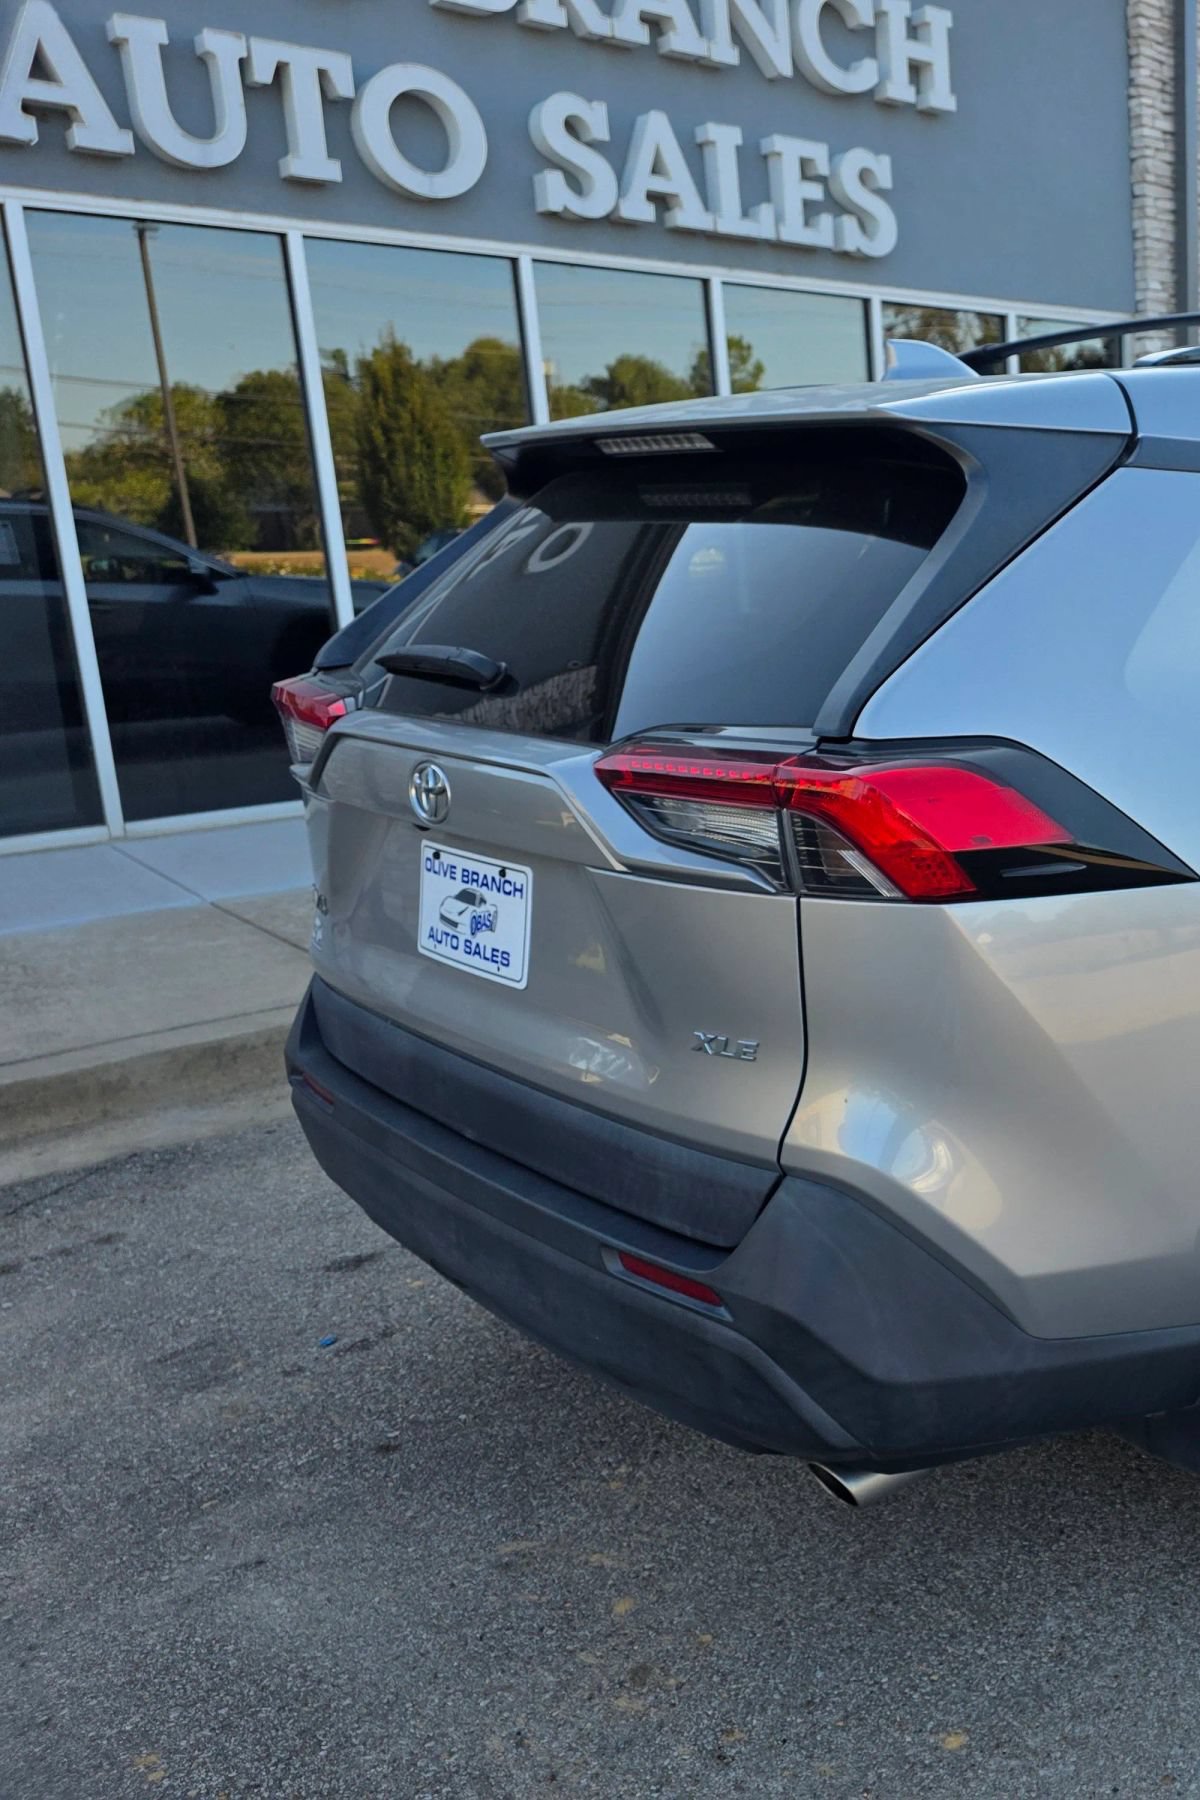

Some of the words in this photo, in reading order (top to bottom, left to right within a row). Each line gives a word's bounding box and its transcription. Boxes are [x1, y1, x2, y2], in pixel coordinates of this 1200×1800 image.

[429, 0, 957, 115] ANCH
[0, 2, 488, 200] AUTO
[527, 91, 899, 259] SALES
[425, 857, 457, 881] OLIVE
[461, 868, 524, 899] BRANCH
[428, 926, 460, 950] AUTO
[463, 939, 510, 967] SALES
[691, 1031, 760, 1061] XLE
